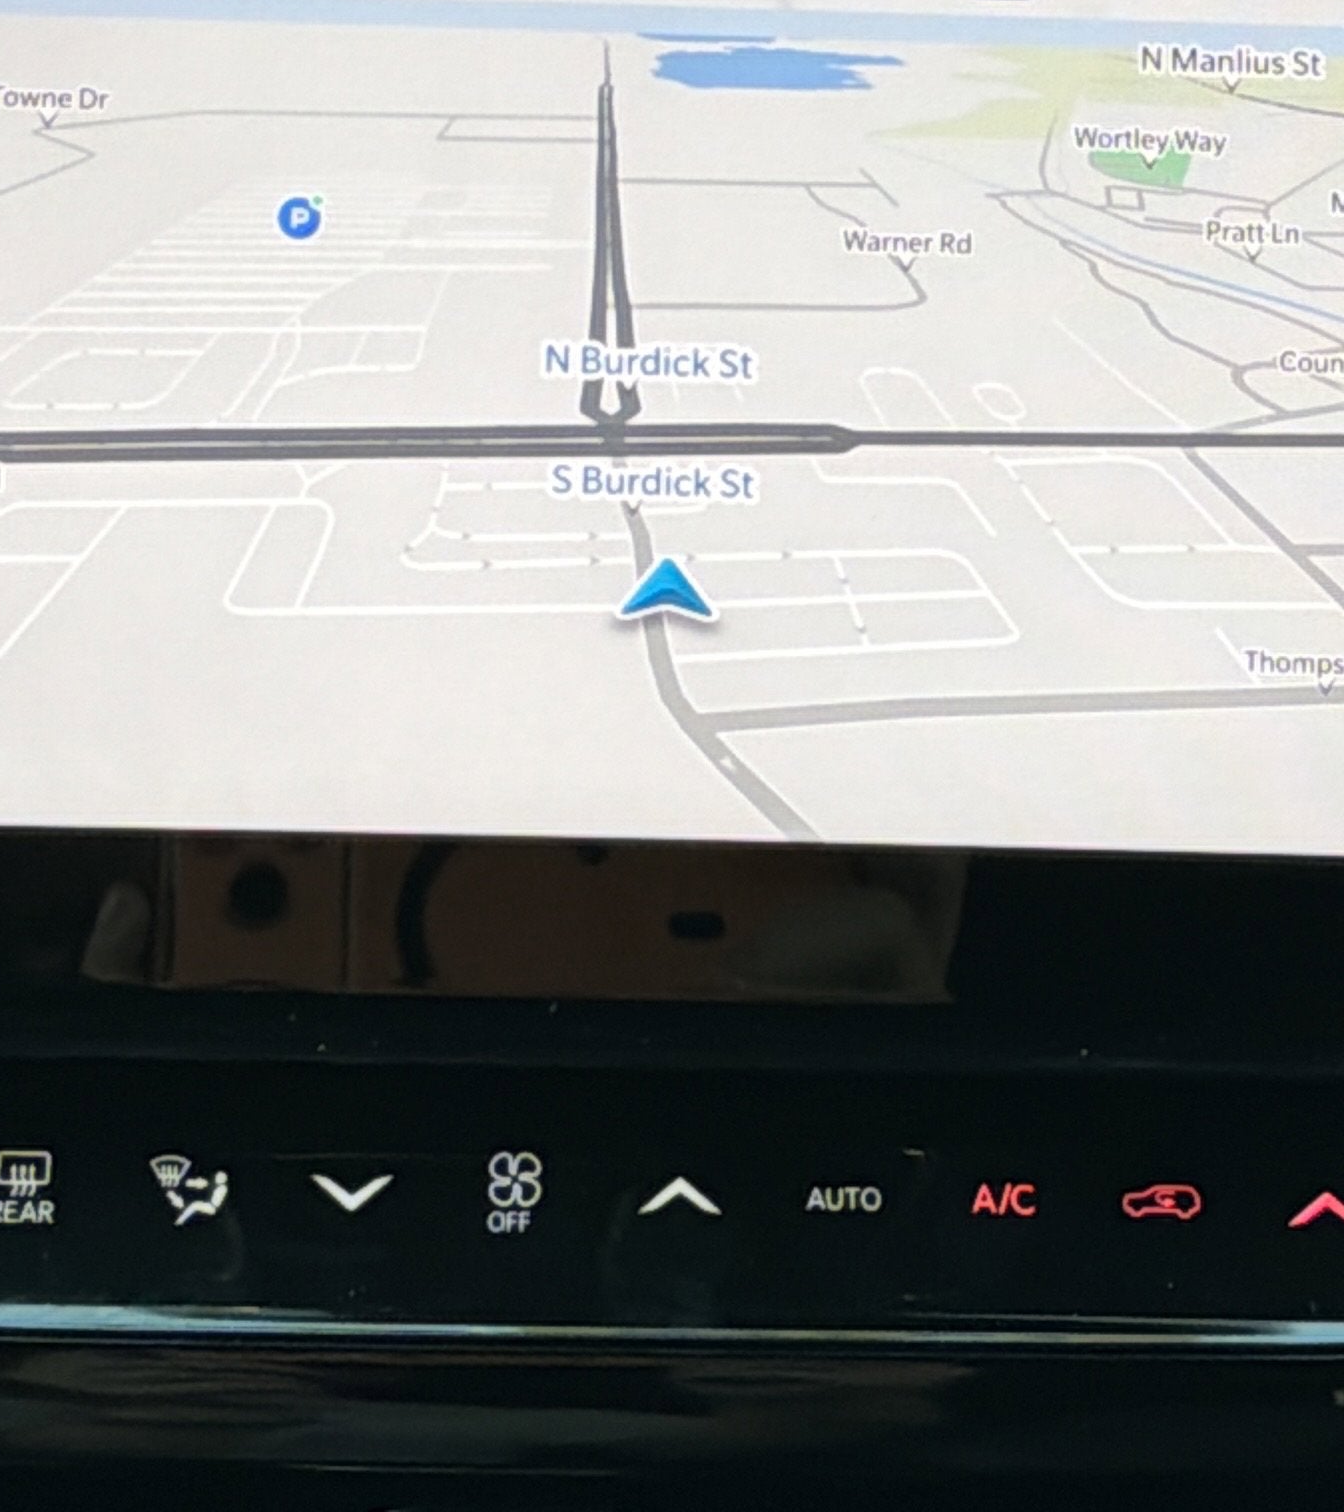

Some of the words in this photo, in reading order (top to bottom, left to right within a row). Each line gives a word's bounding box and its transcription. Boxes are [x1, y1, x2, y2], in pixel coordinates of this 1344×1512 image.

[1141, 48, 1163, 72] N
[1170, 48, 1284, 75] Manlius
[1292, 52, 1323, 78] St
[78, 88, 109, 112] Dr
[1075, 128, 1168, 156] Wortley
[1174, 130, 1226, 156] Way
[843, 230, 932, 254] Warner
[940, 232, 972, 255] Rd
[1207, 221, 1264, 244] Pratt
[1271, 222, 1300, 245] Ln
[545, 346, 570, 376] N
[581, 345, 711, 379] Burdick
[720, 350, 754, 380] St
[552, 466, 574, 495] S
[582, 466, 711, 497] Burdick
[720, 471, 755, 500] St
[806, 1186, 882, 1212] AUTO
[972, 1183, 1035, 1216] A/C
[487, 1211, 531, 1234] OFF
